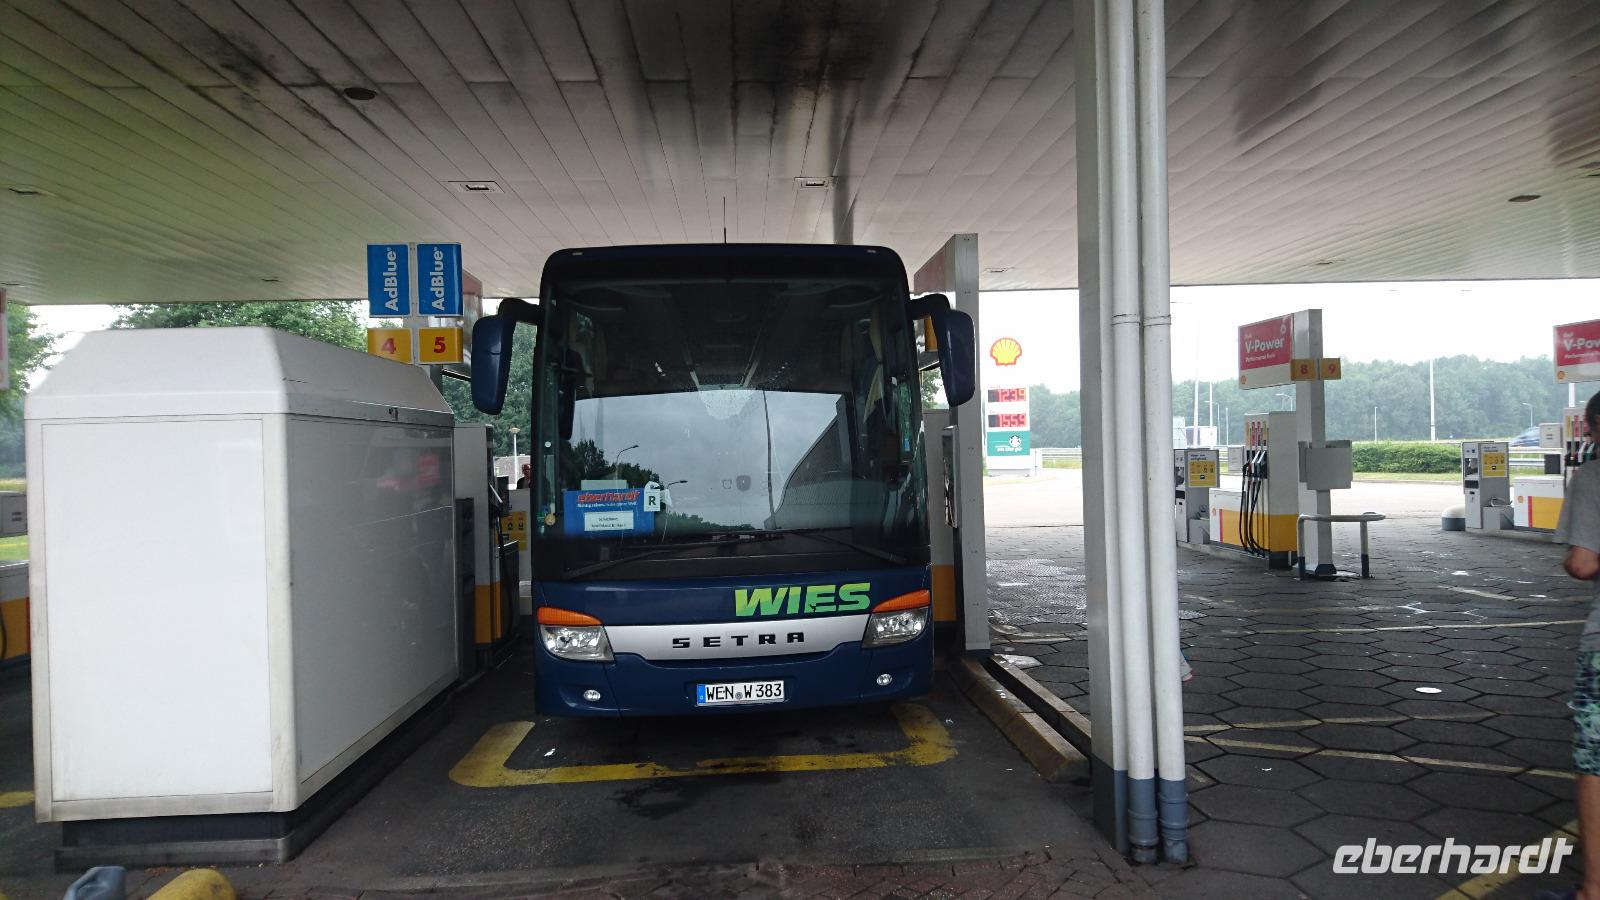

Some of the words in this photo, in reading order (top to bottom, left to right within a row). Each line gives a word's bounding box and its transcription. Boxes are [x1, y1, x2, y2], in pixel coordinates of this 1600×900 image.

[383, 249, 399, 312] AdBlue
[430, 249, 445, 311] AdBlue
[381, 338, 396, 354] 4
[434, 337, 446, 353] 5
[1245, 337, 1285, 354] V-Power
[1300, 364, 1308, 374] 8
[1328, 364, 1336, 374] 9
[648, 496, 656, 506] R
[735, 582, 871, 617] WIES
[672, 632, 805, 648] SETRA
[706, 685, 734, 701] WEN
[743, 684, 753, 699] W
[756, 683, 782, 698] 383
